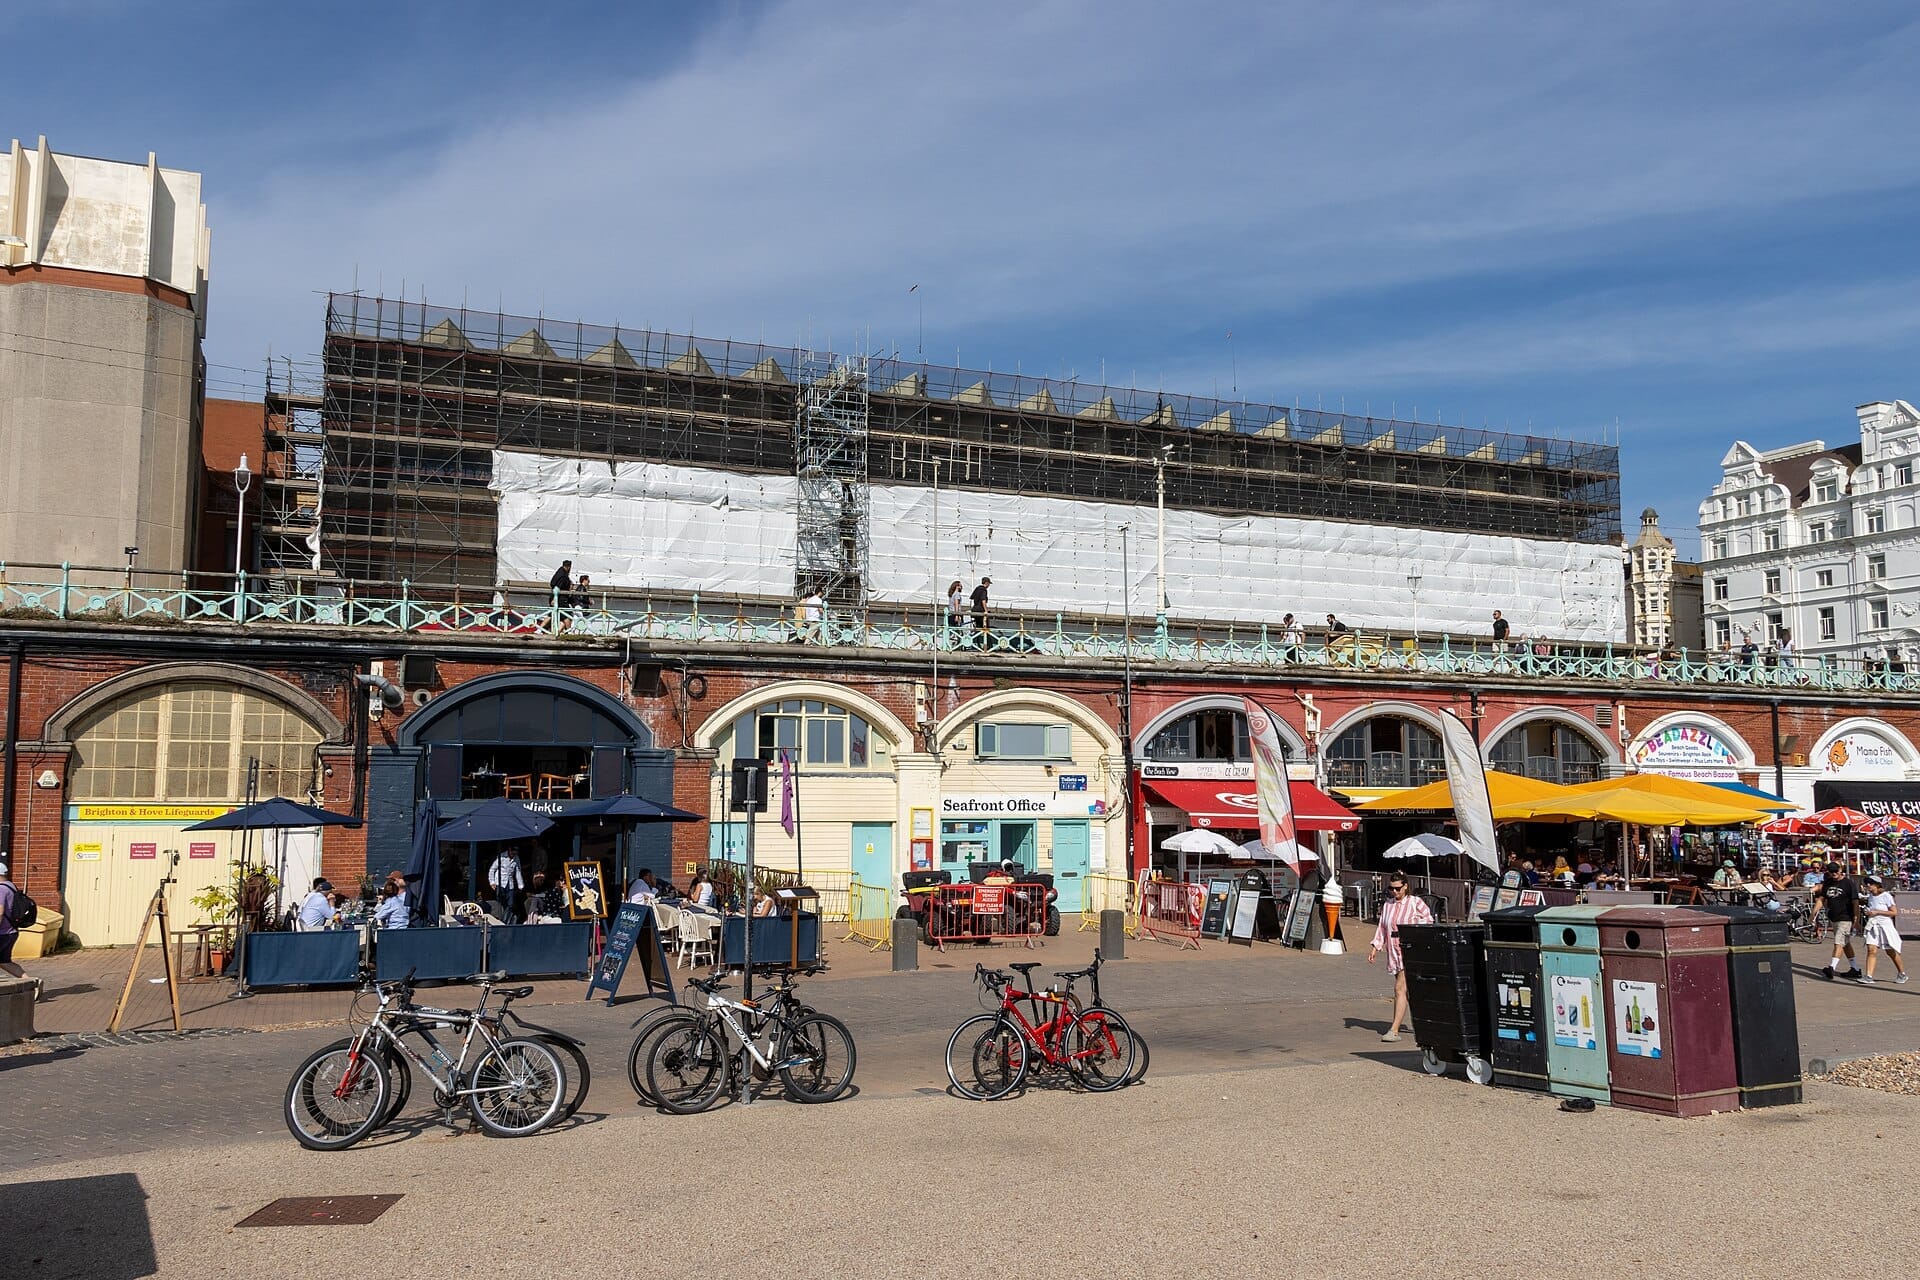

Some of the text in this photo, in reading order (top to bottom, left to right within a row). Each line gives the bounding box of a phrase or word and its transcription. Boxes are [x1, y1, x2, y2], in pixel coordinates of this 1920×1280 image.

[1856, 746, 1893, 756] Mama Fish
[1667, 770, 1692, 778] Famous
[943, 799, 1046, 812] Seafront Office
[1861, 801, 1890, 815] FISH
[1891, 801, 1902, 814] &
[84, 808, 215, 818] Brighton & Hove Lifeguards
